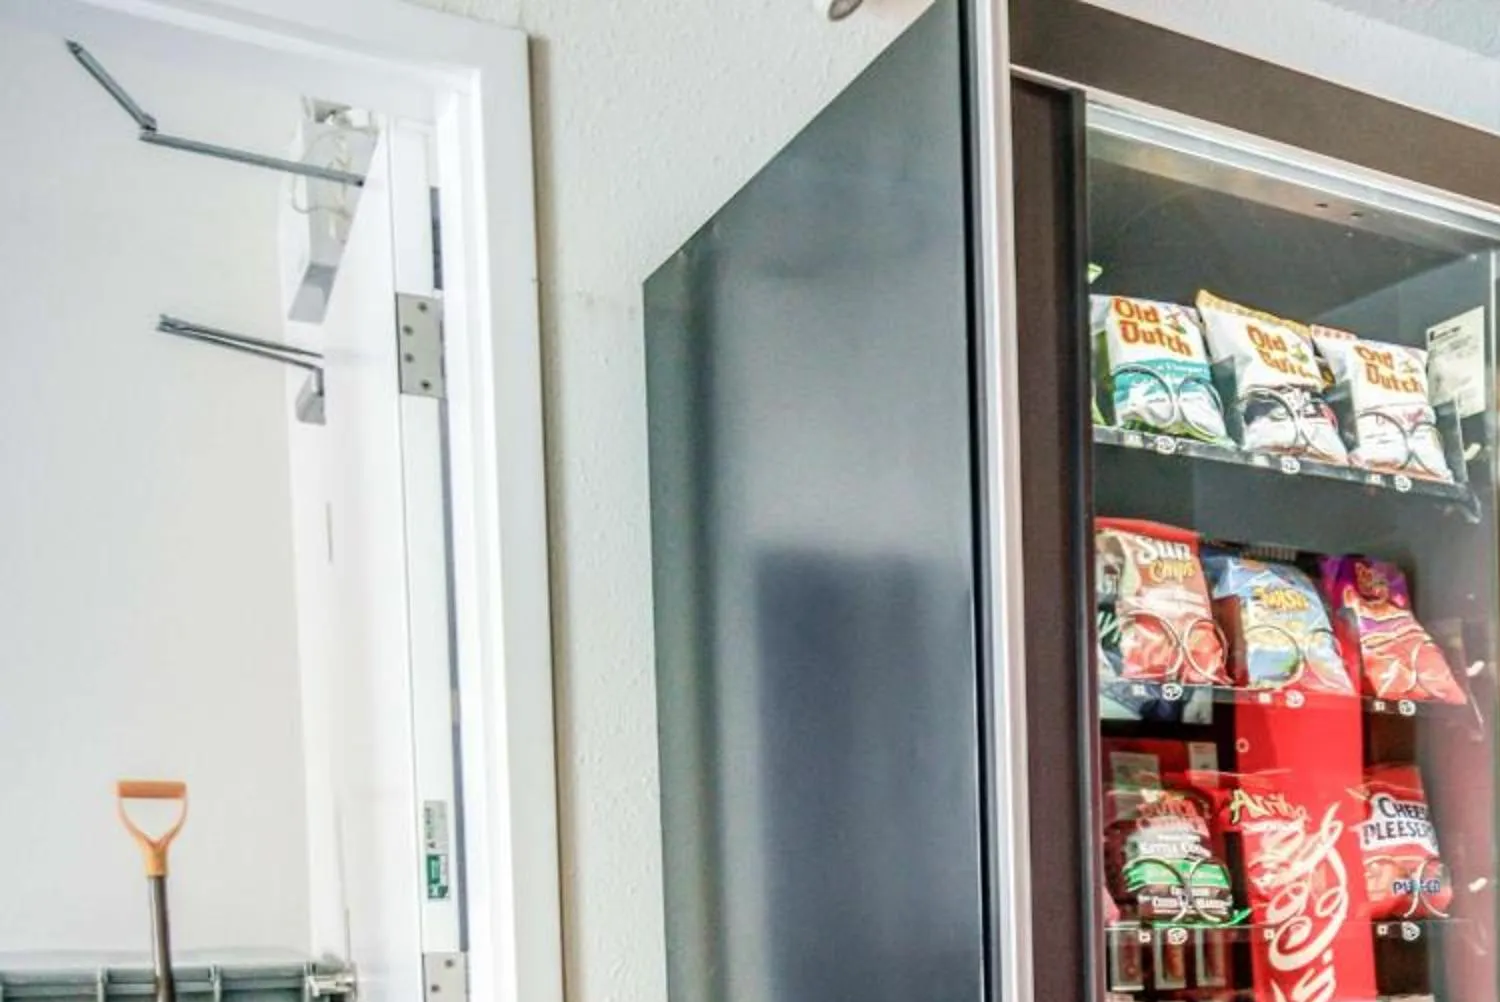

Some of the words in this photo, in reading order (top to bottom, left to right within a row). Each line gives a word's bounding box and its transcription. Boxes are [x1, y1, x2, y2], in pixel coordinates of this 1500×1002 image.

[1113, 297, 1160, 324] Old
[1119, 319, 1193, 357] Dutch
[1246, 324, 1288, 353] Old
[1353, 344, 1395, 371] Old
[1364, 361, 1426, 394] Dutch
[1136, 535, 1192, 566] Sun
[1363, 820, 1438, 847] PLEESE
